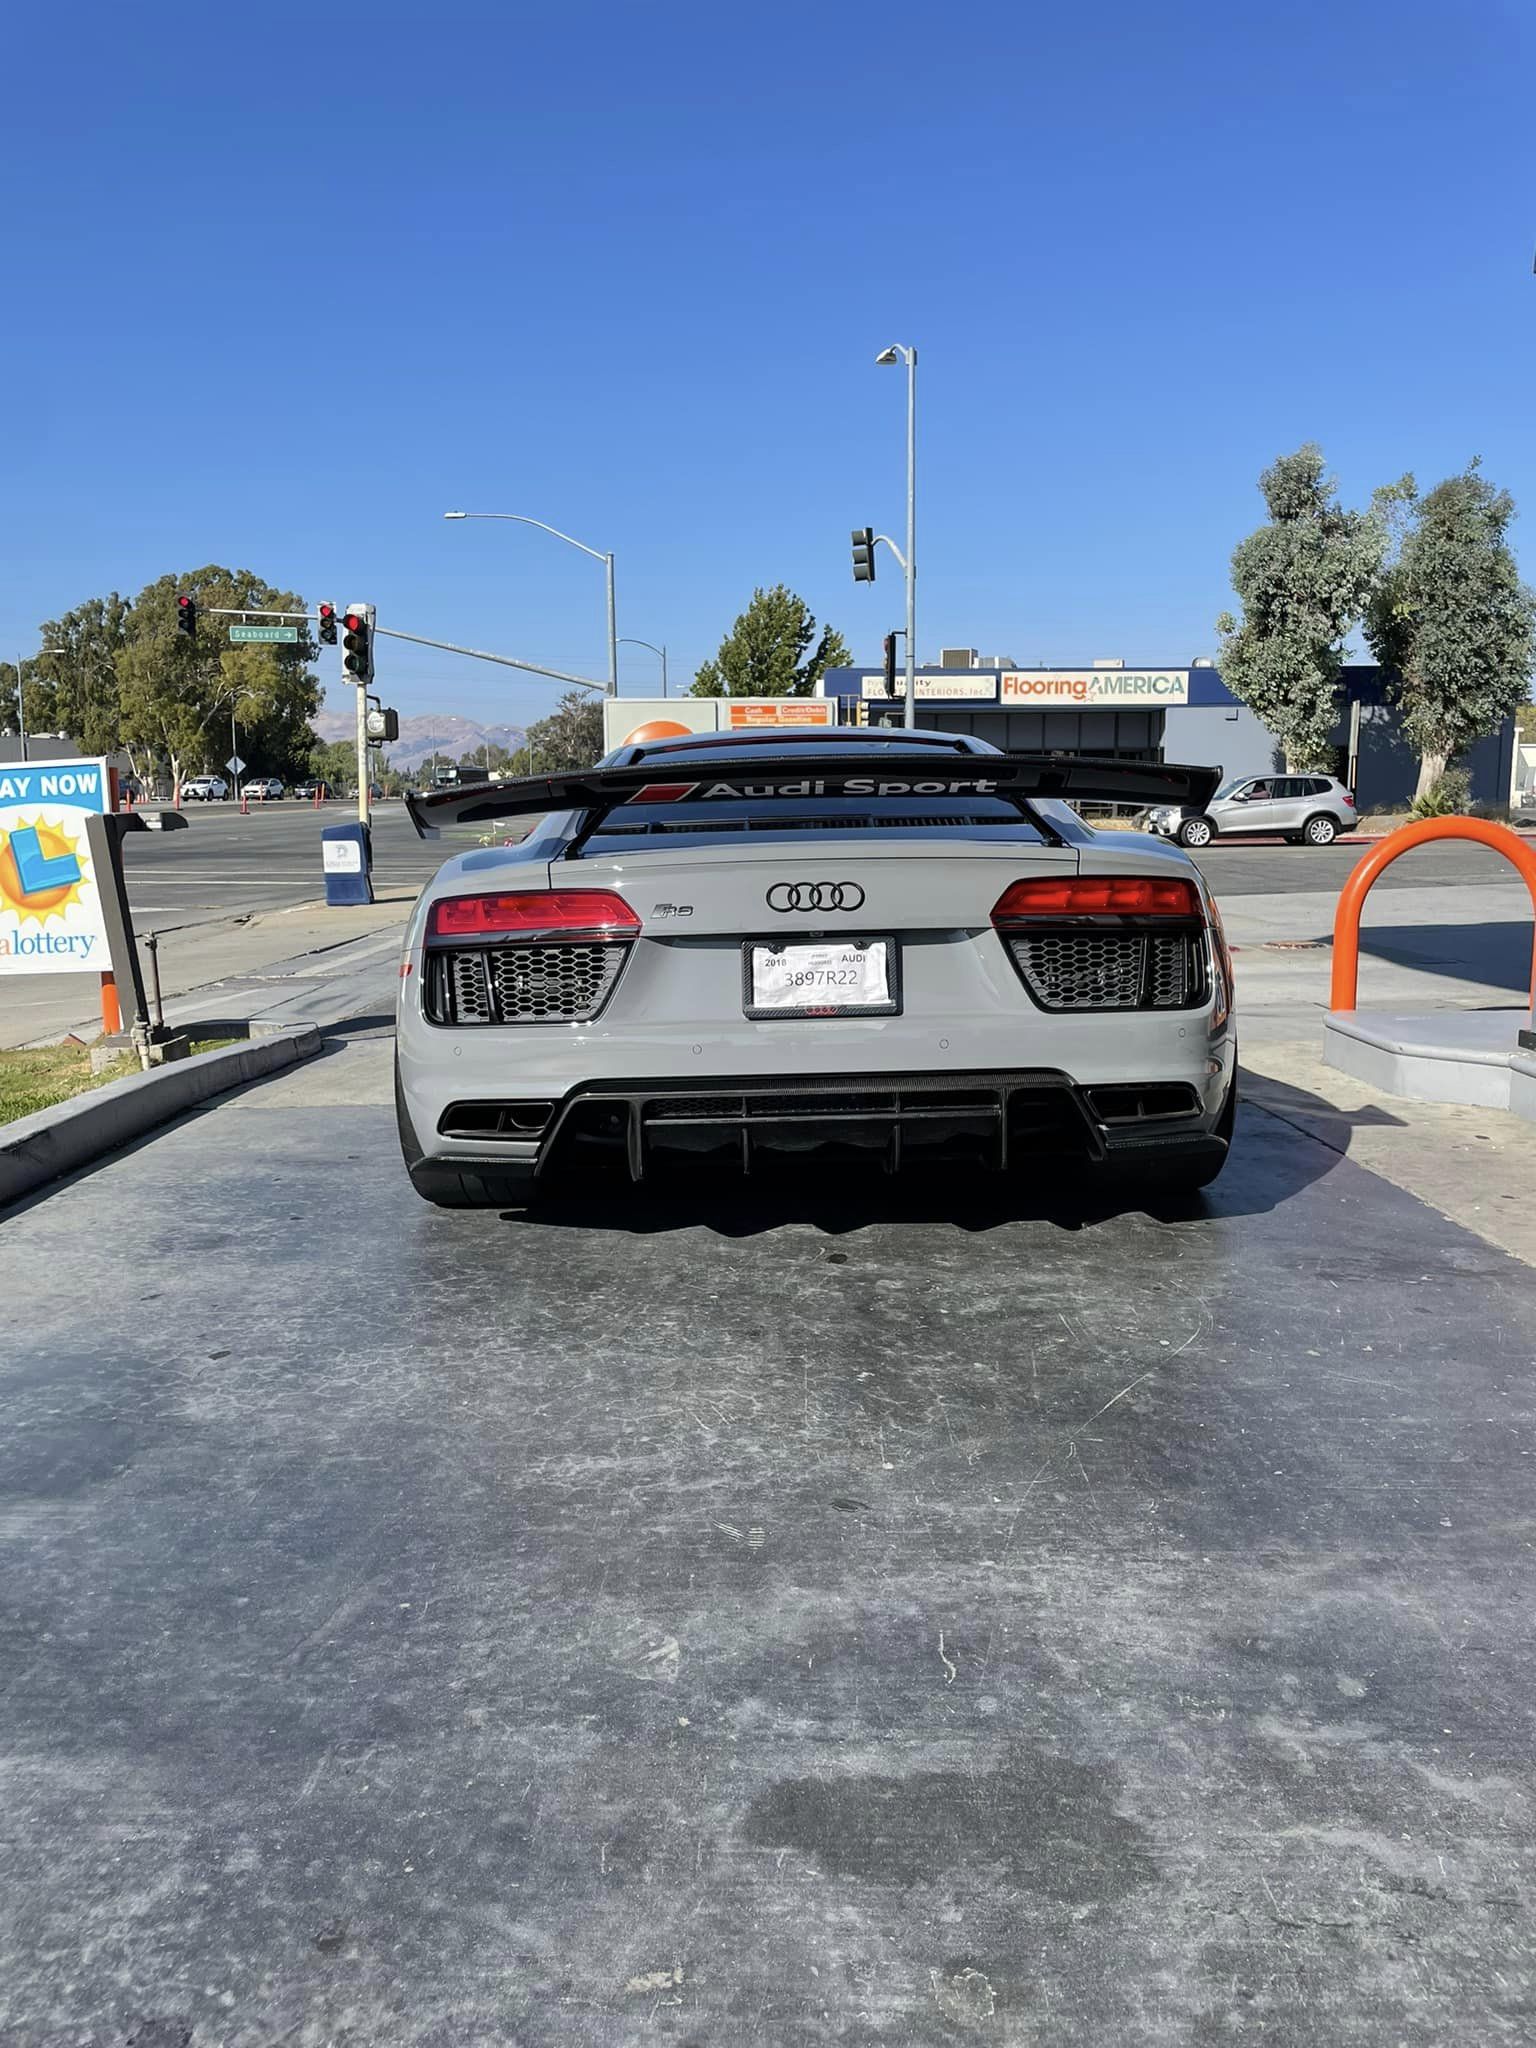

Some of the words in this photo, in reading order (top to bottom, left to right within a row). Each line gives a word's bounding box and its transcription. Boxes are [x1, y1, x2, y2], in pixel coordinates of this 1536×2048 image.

[234, 629, 280, 639] Seaboard
[1003, 676, 1087, 700] Flooring
[1088, 675, 1185, 695] AMERICA
[744, 706, 763, 714] Cash
[40, 773, 98, 797] NOW
[702, 780, 825, 798] Audi
[842, 779, 997, 796] Sport
[841, 953, 866, 963] AUDI
[785, 970, 858, 987] 3897R22
